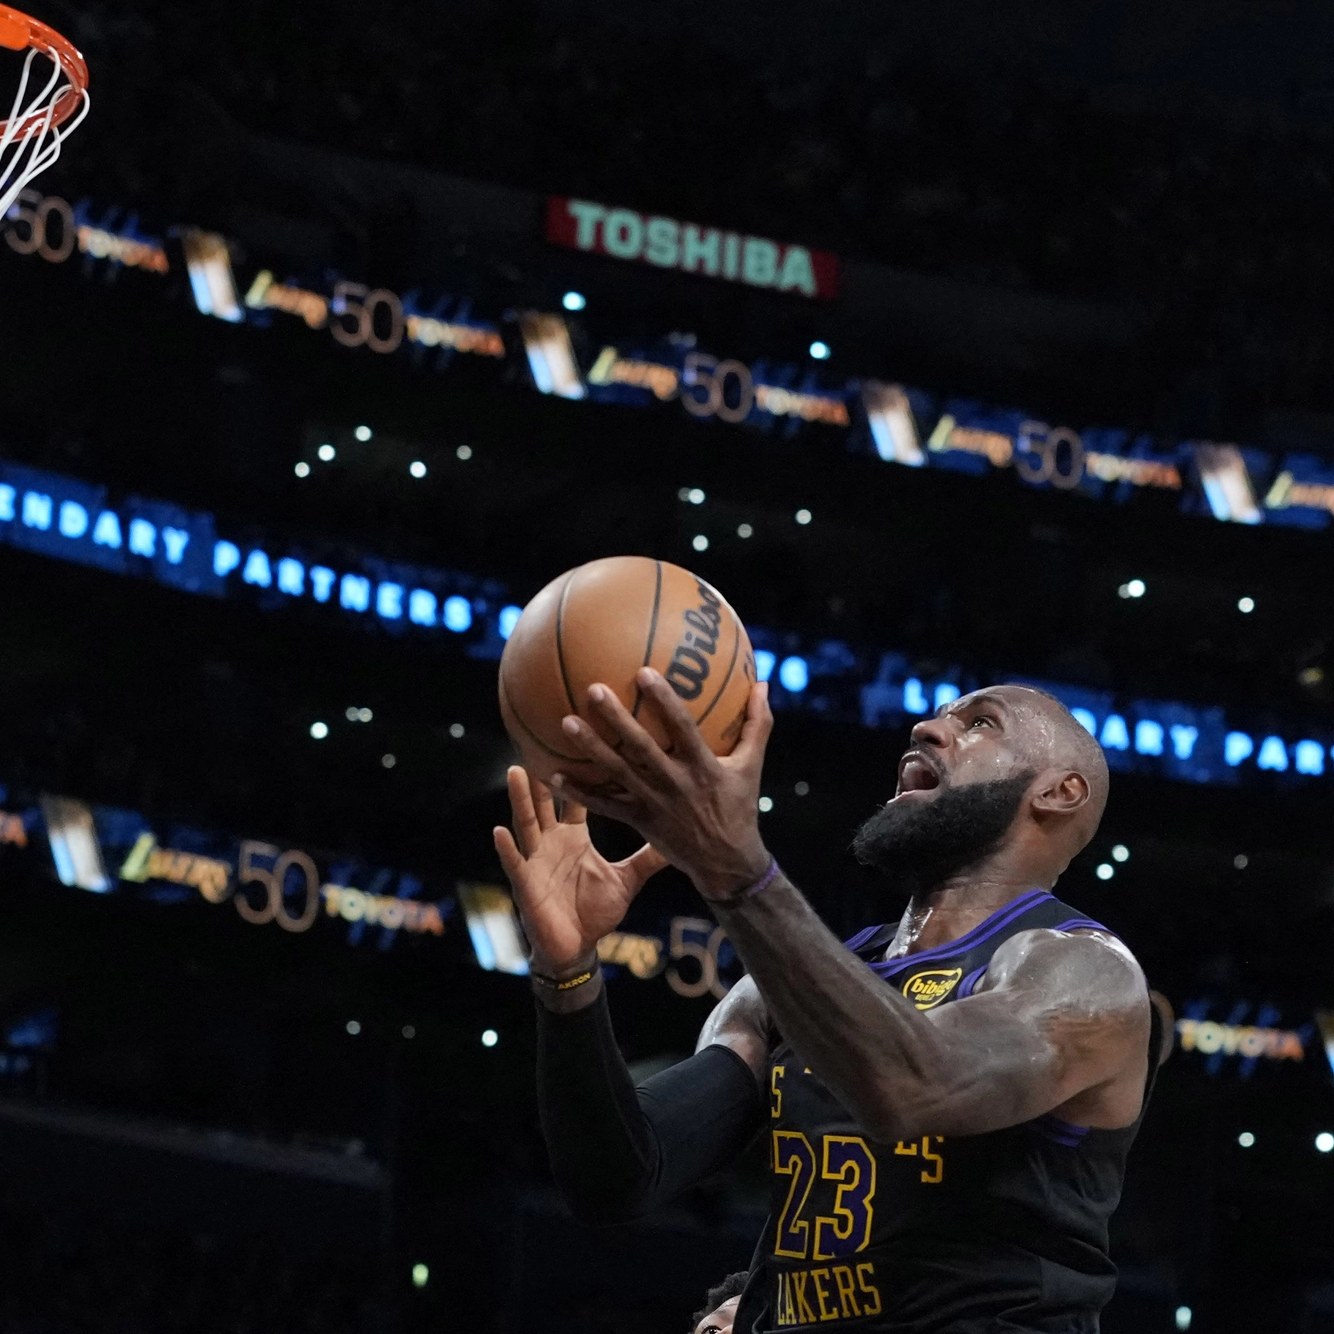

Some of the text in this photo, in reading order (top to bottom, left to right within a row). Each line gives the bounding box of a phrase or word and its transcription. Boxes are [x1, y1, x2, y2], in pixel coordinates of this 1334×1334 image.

[4, 189, 74, 263] 50
[567, 199, 818, 297] TOSHIBA
[330, 281, 405, 353] 50
[680, 352, 754, 423] 50
[1014, 420, 1085, 490] 50
[213, 540, 472, 633] PARTNERS
[665, 579, 721, 701] Wilso
[234, 839, 320, 932] 50
[323, 884, 445, 936] TOYOTA
[558, 972, 591, 990] AKRON
[910, 978, 957, 996] bibigo
[771, 1130, 876, 1261] 23
